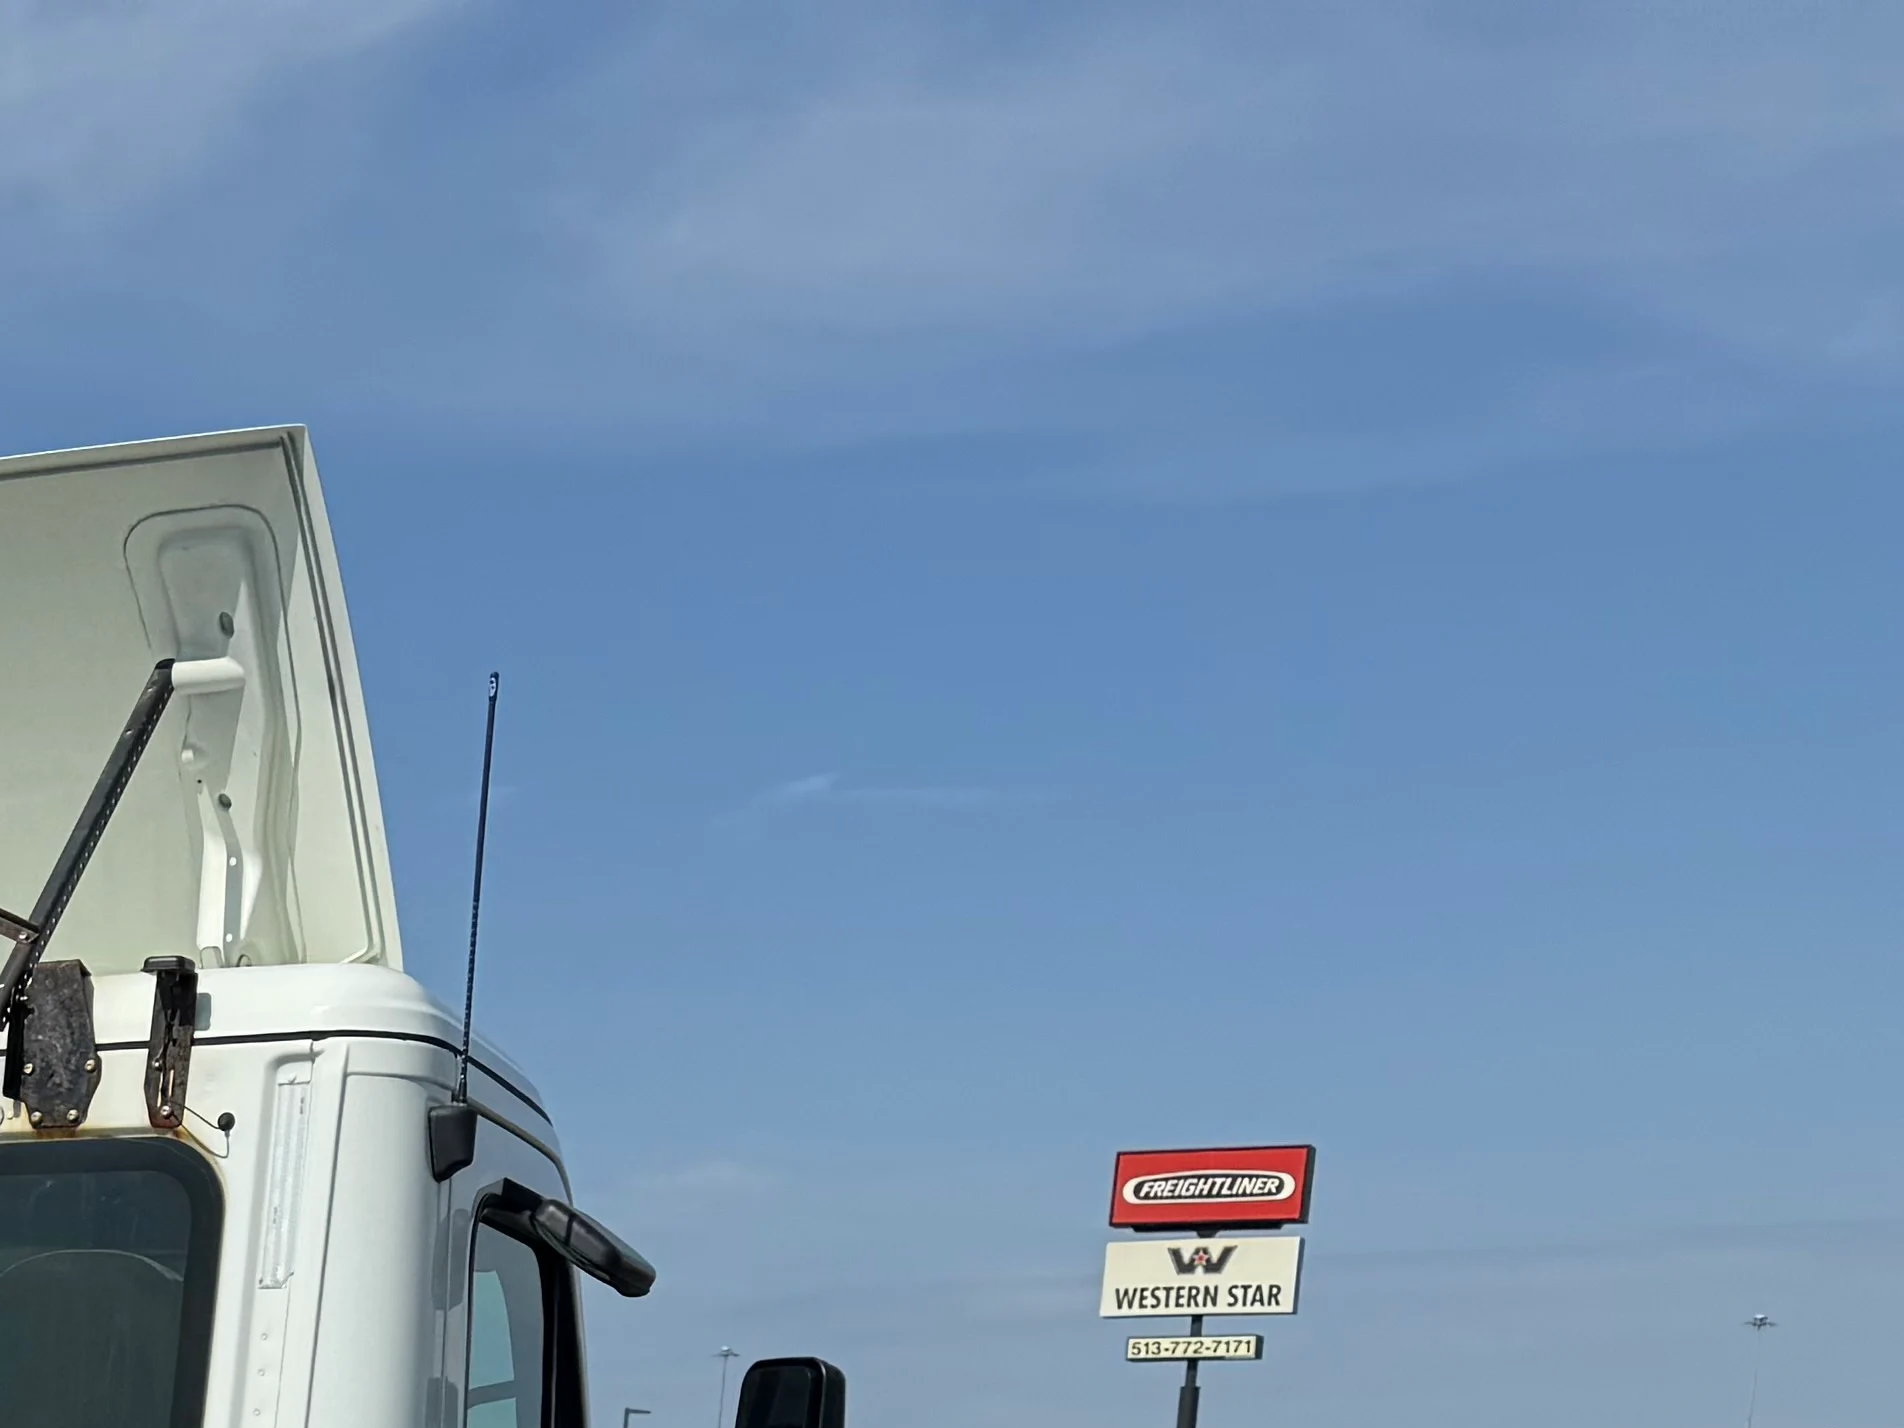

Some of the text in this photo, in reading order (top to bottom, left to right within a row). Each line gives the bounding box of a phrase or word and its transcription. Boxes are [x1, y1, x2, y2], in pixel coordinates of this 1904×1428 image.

[1139, 1176, 1280, 1198] FREIGHTLINER
[1115, 1284, 1282, 1310] WESTERN STAR
[1131, 1339, 1252, 1357] 513-772-7171
